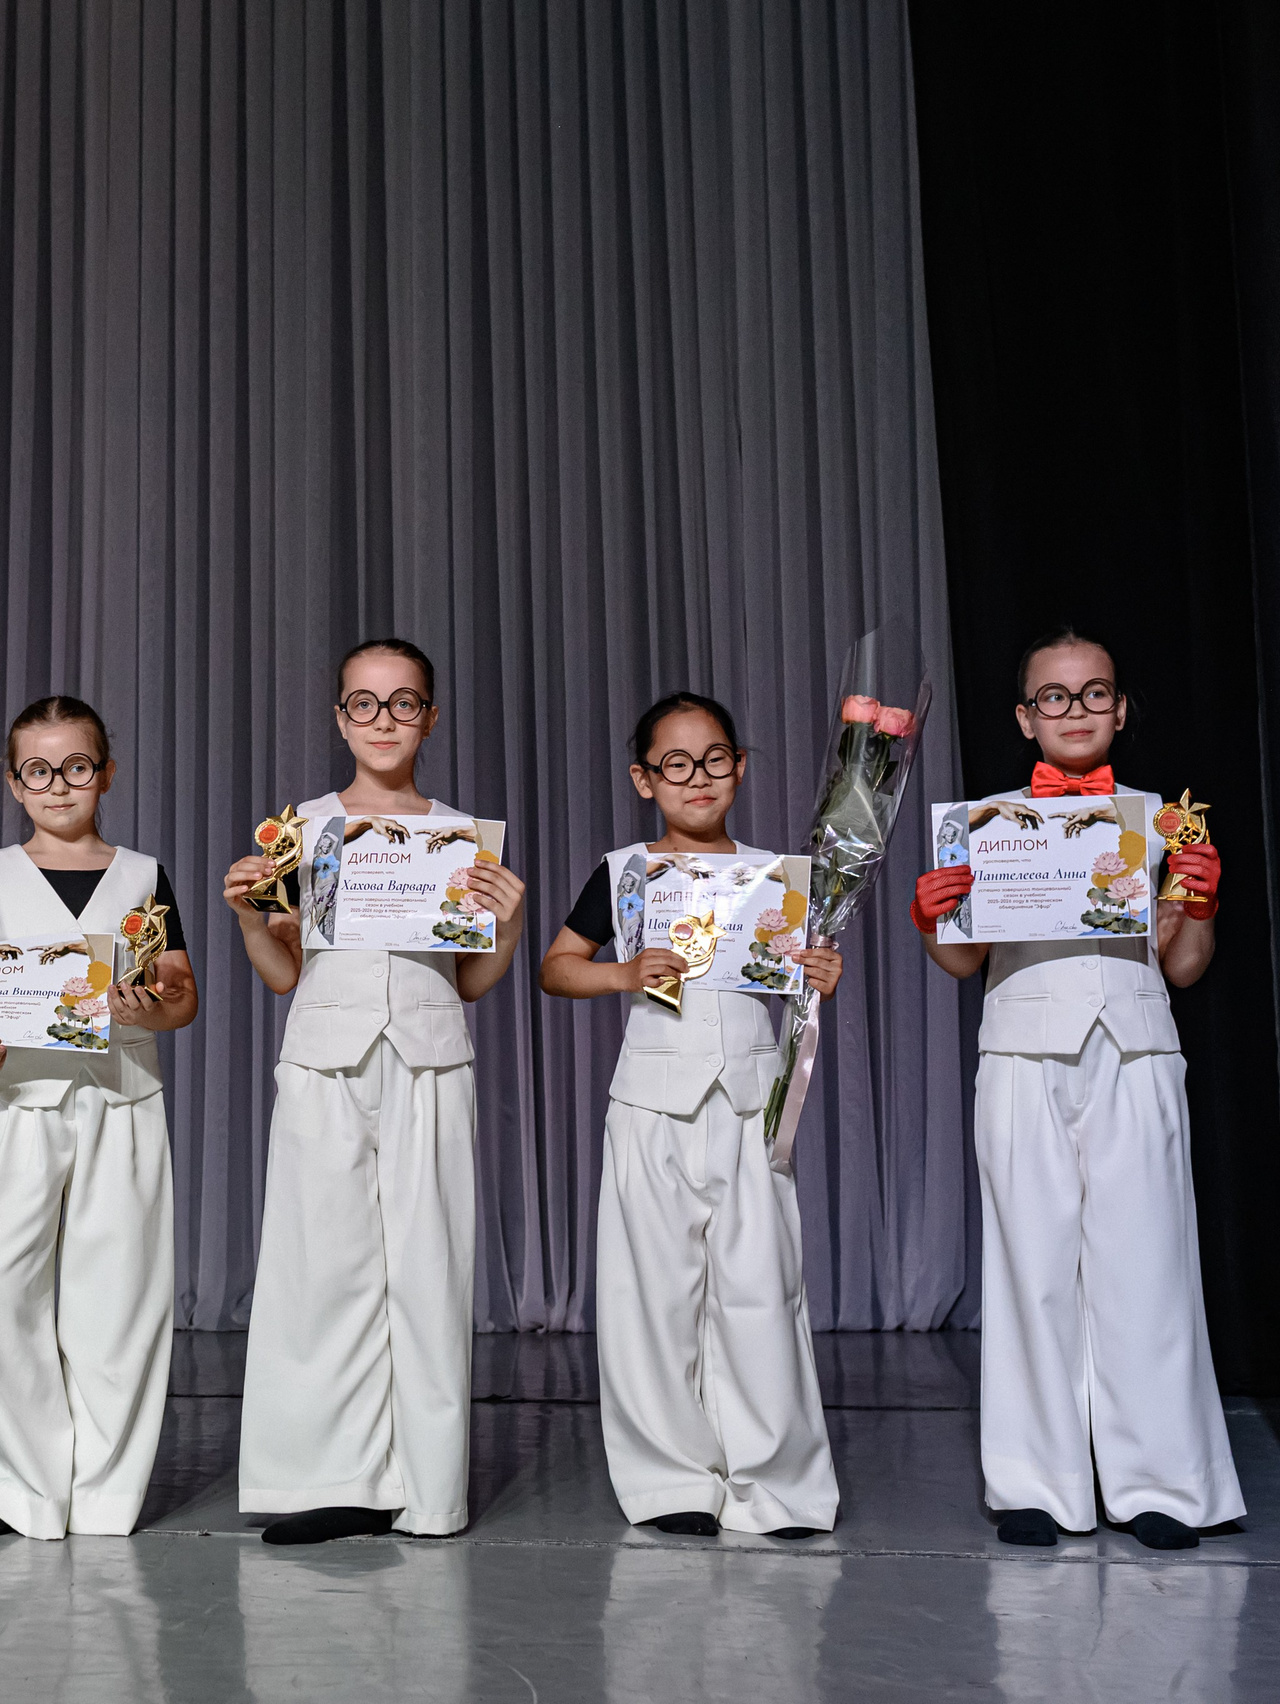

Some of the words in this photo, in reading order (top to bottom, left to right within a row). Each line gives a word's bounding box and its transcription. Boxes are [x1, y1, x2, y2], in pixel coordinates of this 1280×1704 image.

[977, 839, 1048, 854] ДИПЛОМ
[348, 852, 411, 865] ДИПЛОМ
[973, 869, 1049, 881] Пантелеева
[1053, 868, 1087, 880] Анна
[341, 879, 384, 891] Хахова
[387, 879, 436, 895] Варвара
[652, 891, 717, 904] ДИПЛ
[648, 918, 671, 930] Цой
[12, 987, 66, 999] Виктория
